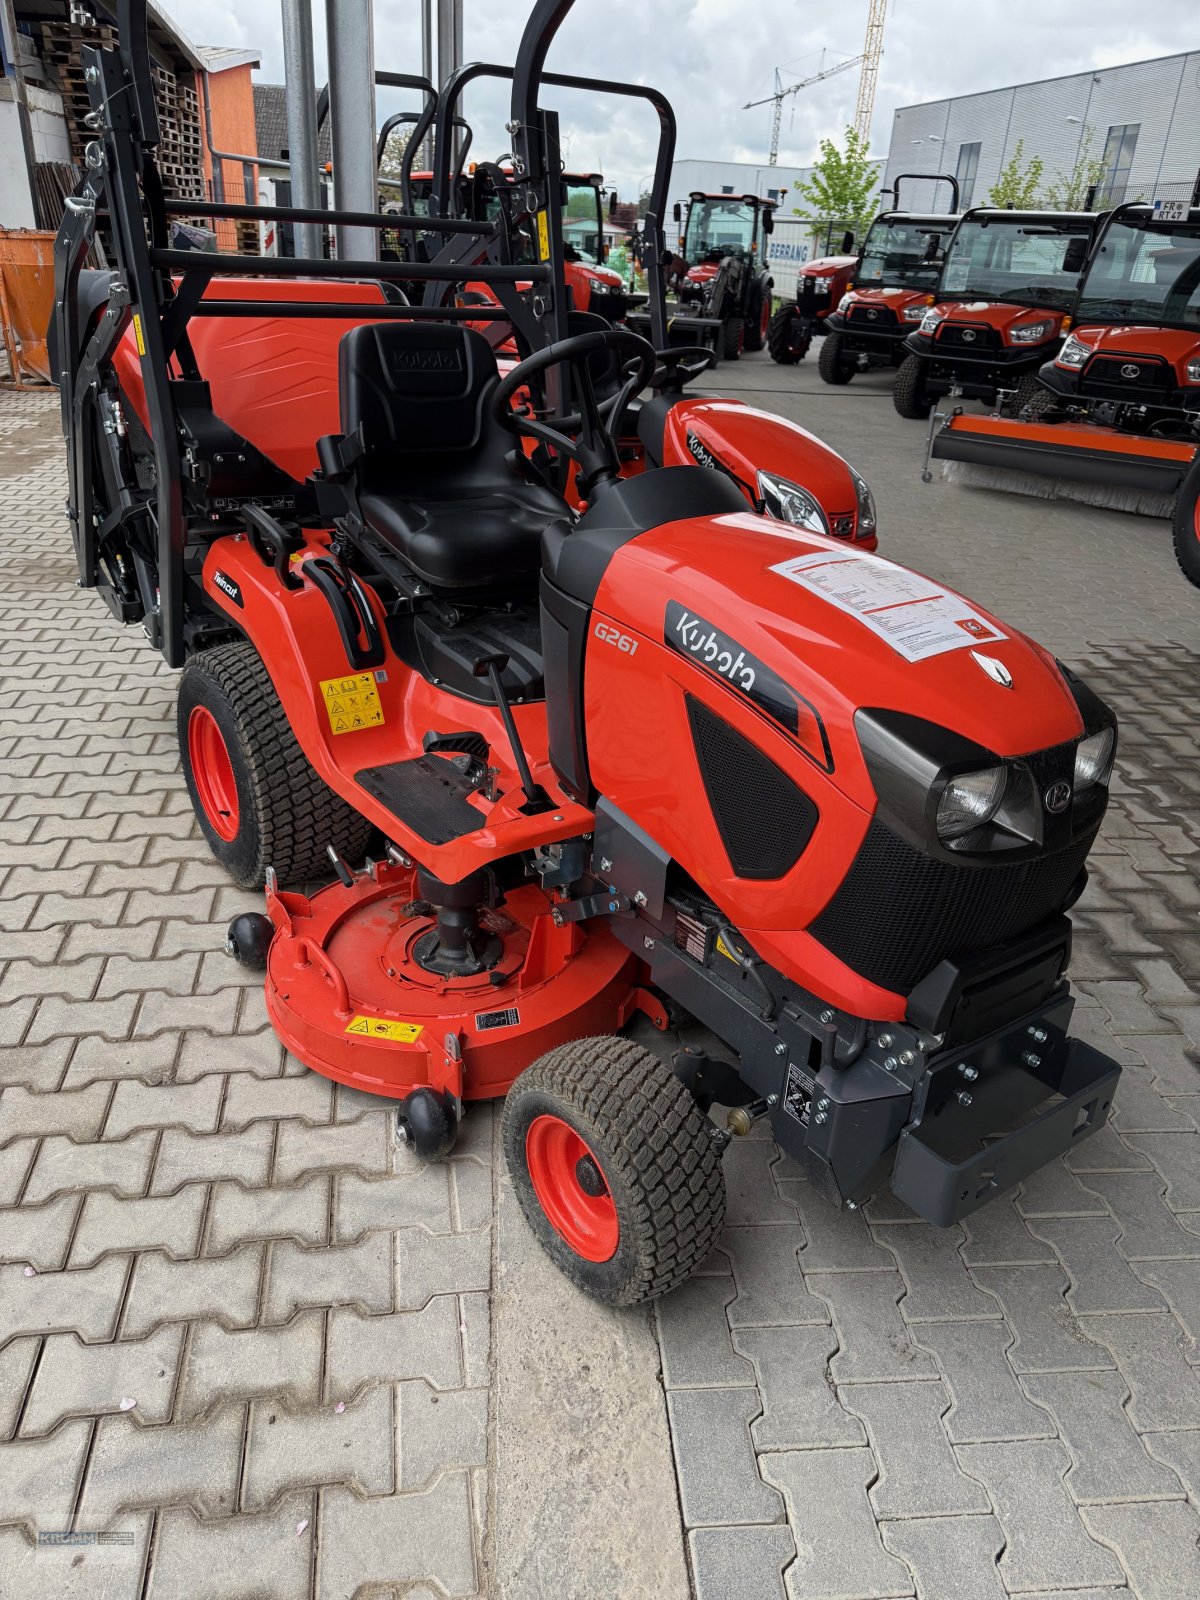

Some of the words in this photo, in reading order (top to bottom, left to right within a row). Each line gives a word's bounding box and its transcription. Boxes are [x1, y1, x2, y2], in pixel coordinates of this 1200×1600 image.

[1163, 202, 1176, 211] FR
[769, 242, 808, 262] BERRANG
[213, 570, 238, 598] Twincut
[593, 622, 639, 657] G261
[675, 612, 756, 692] Kubota
